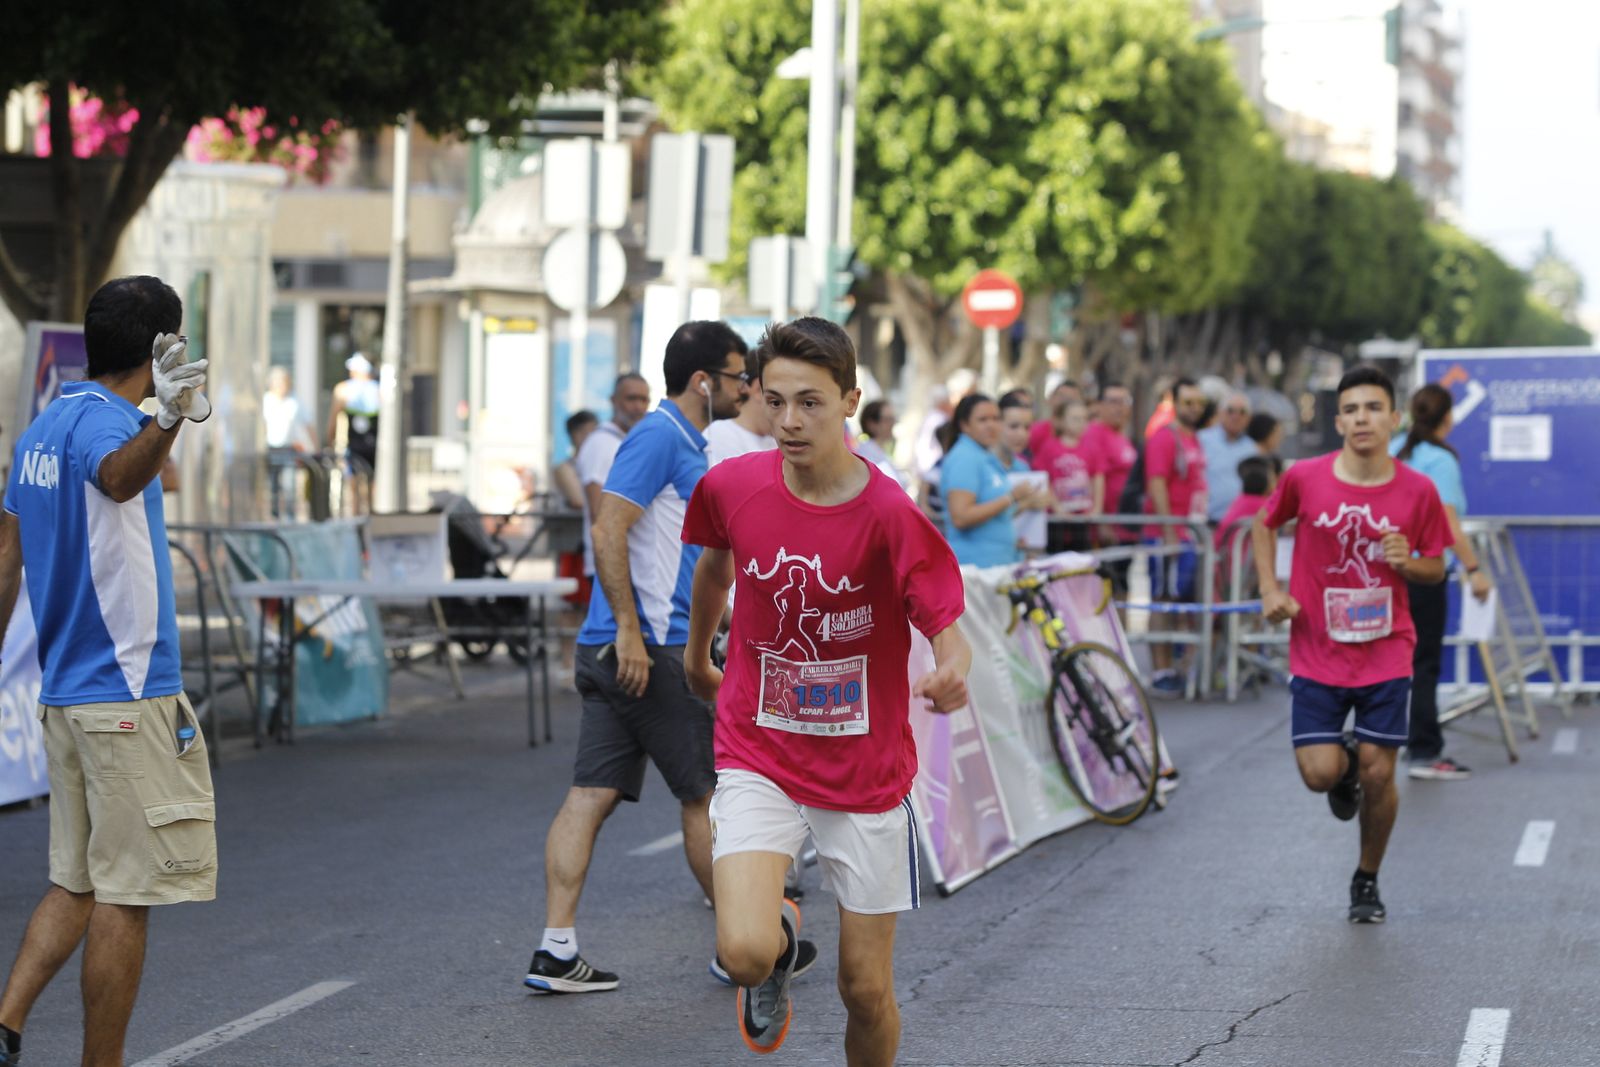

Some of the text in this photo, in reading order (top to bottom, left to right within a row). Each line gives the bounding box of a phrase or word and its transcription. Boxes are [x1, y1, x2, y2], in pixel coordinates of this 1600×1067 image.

[816, 612, 832, 642] 4
[831, 604, 872, 623] CARRERA
[831, 614, 872, 632] SOLIDARIA
[804, 664, 833, 674] CARRERA
[833, 660, 862, 672] SOLIDARIA
[793, 680, 861, 707] 1510
